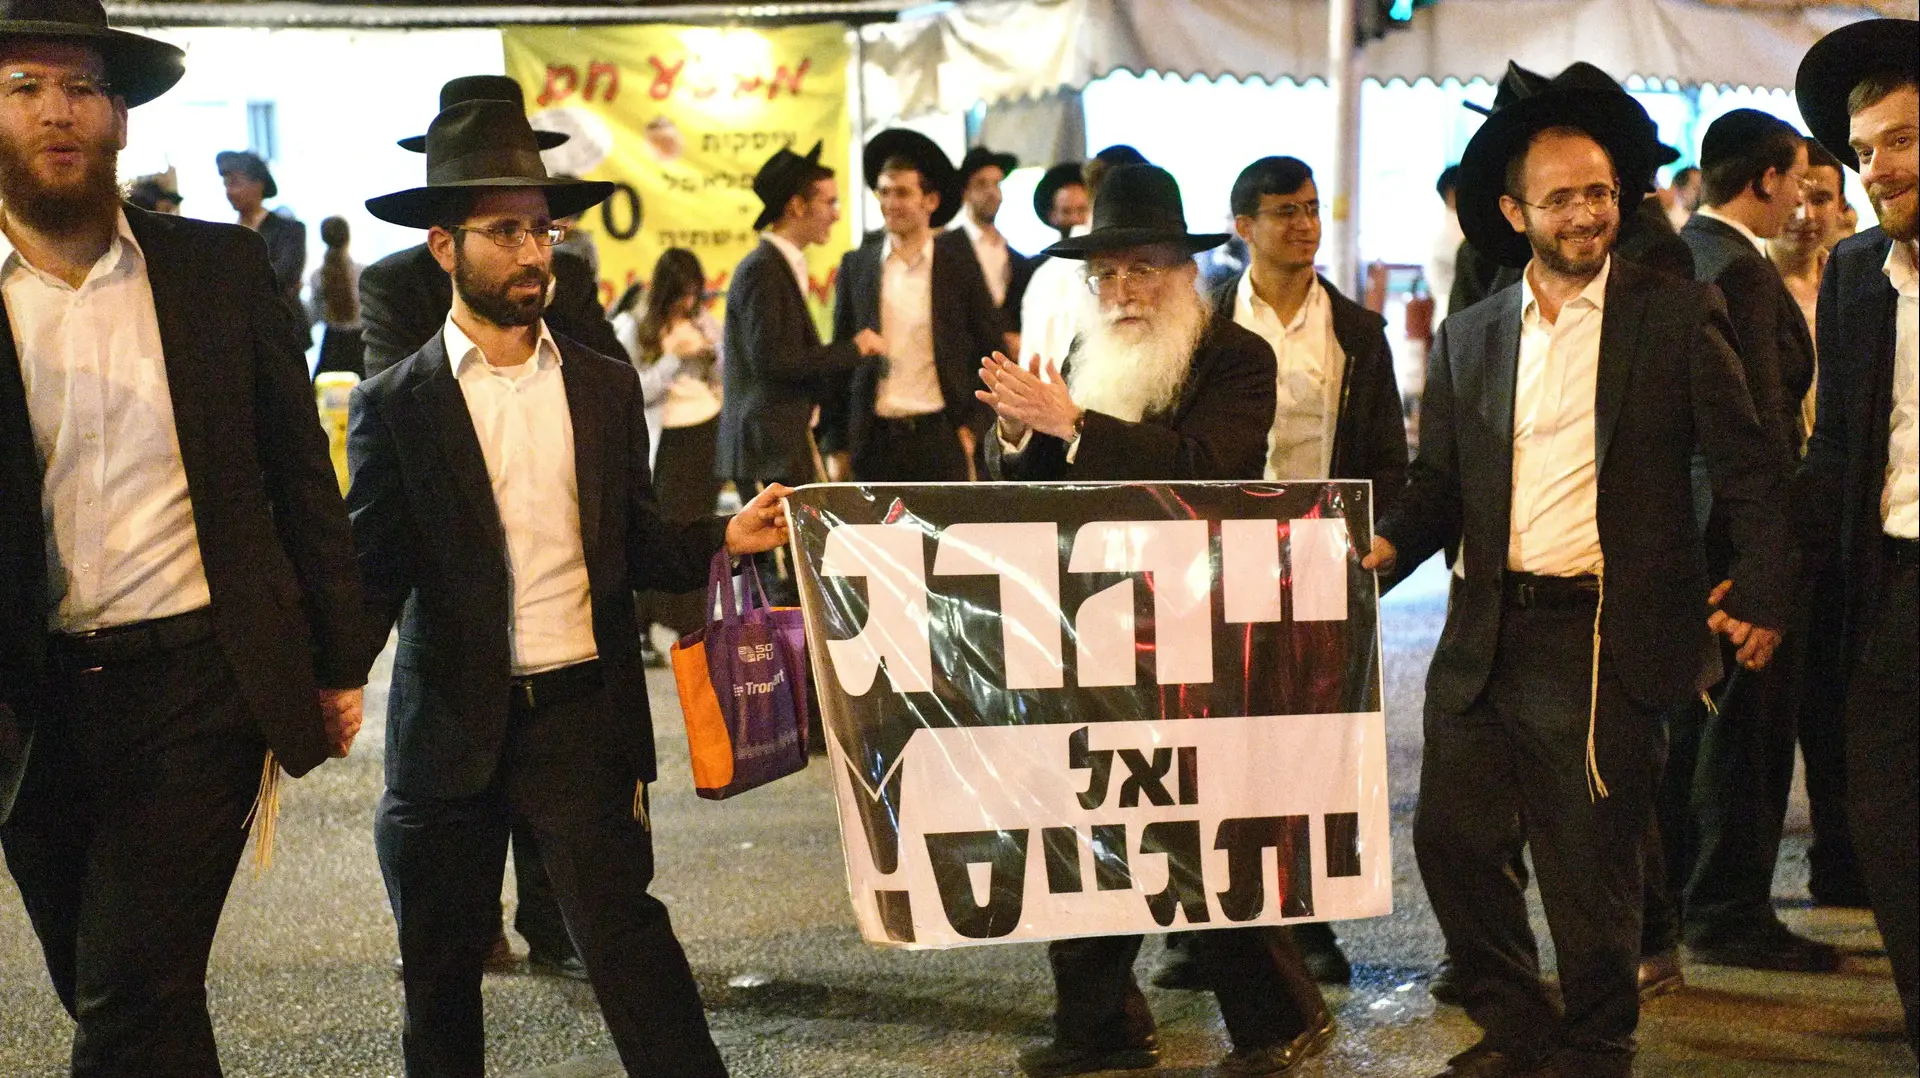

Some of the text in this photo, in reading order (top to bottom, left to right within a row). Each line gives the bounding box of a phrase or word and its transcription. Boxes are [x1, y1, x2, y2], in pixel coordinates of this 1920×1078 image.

[1354, 490, 1362, 501] 3
[820, 517, 1349, 697] ייהרג
[1068, 726, 1199, 810] ואל
